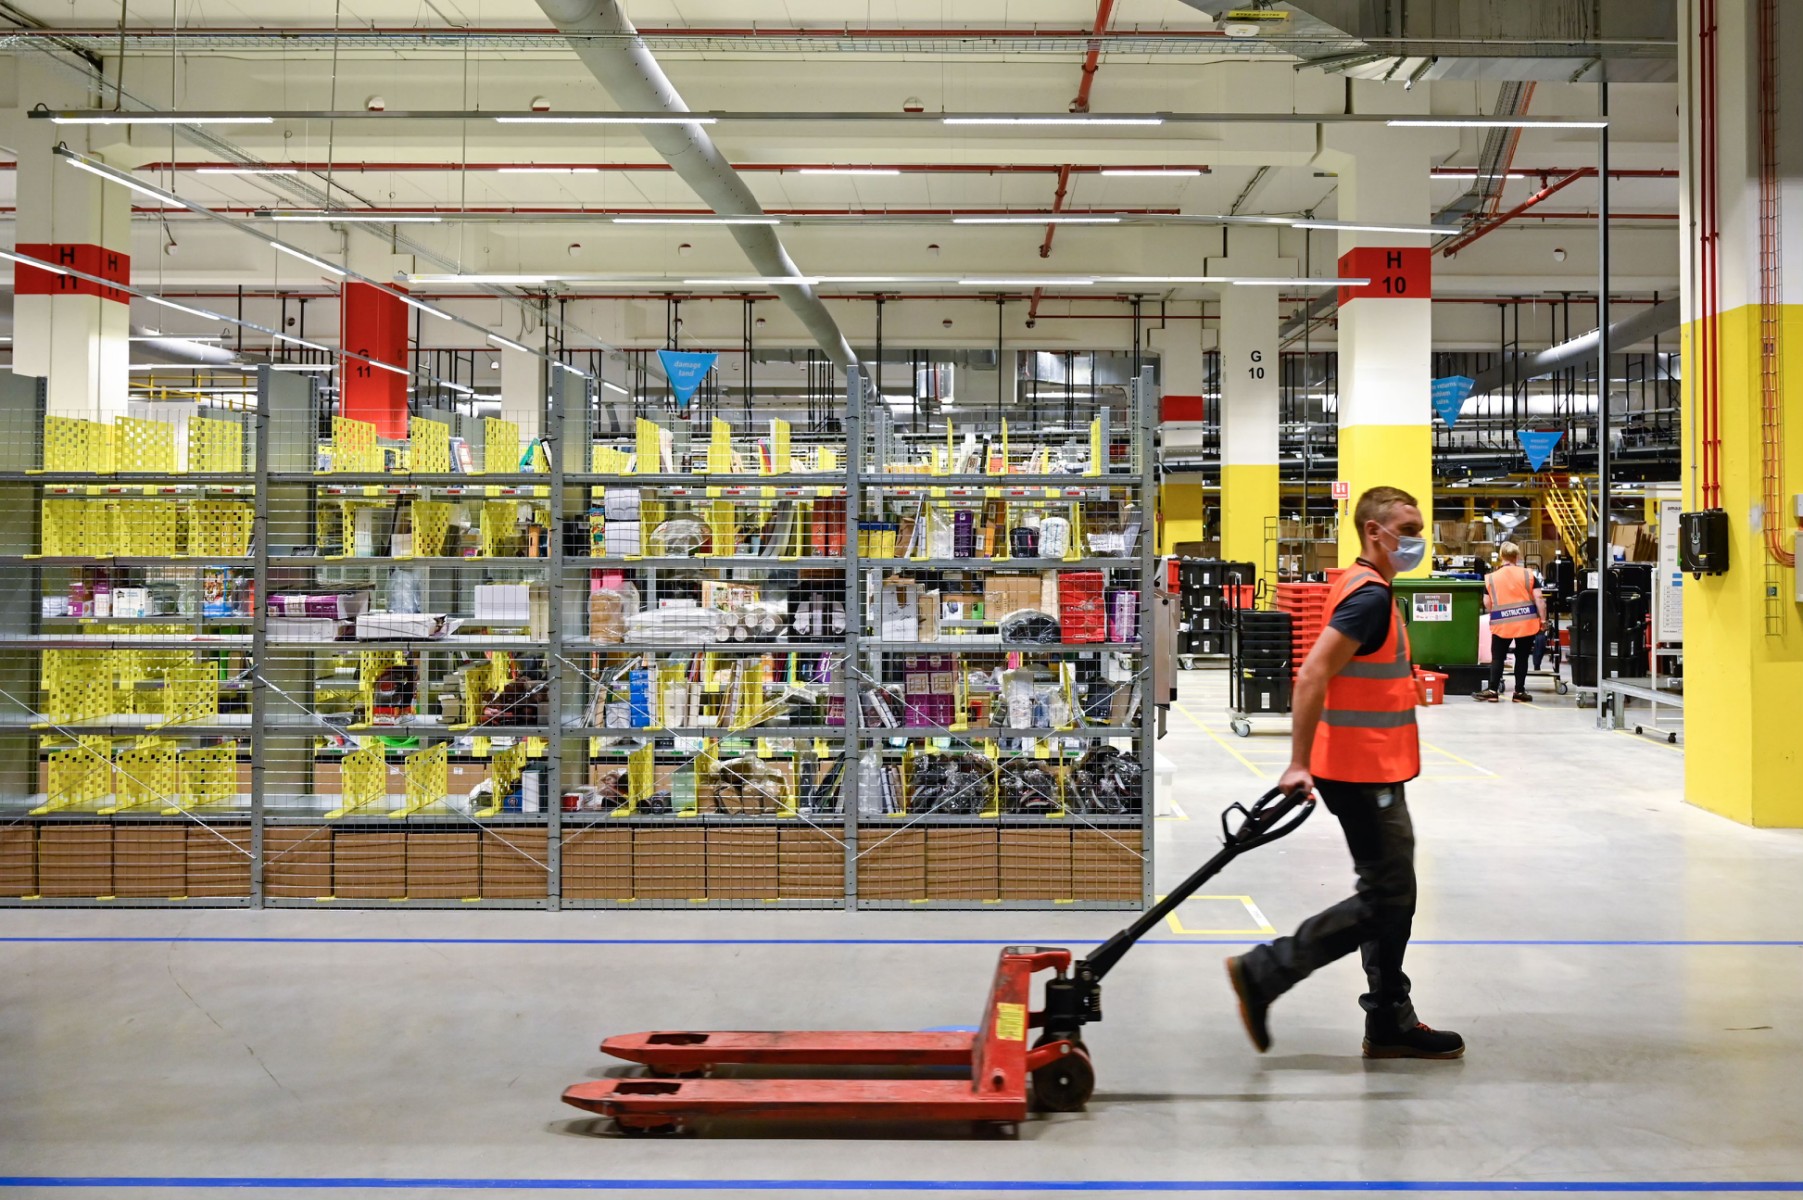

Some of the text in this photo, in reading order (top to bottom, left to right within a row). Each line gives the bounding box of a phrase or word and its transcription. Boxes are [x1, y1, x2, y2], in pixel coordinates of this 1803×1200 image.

[60, 246, 75, 264] H
[1387, 251, 1402, 269] H
[108, 254, 118, 272] H
[57, 272, 77, 290] 11
[1382, 276, 1406, 294] 10
[1250, 350, 1262, 363] G
[357, 365, 371, 378] 11
[673, 360, 701, 370] damage
[678, 369, 695, 377] land
[1248, 367, 1265, 379] 10
[1501, 606, 1531, 618] INSTRUCTOR
